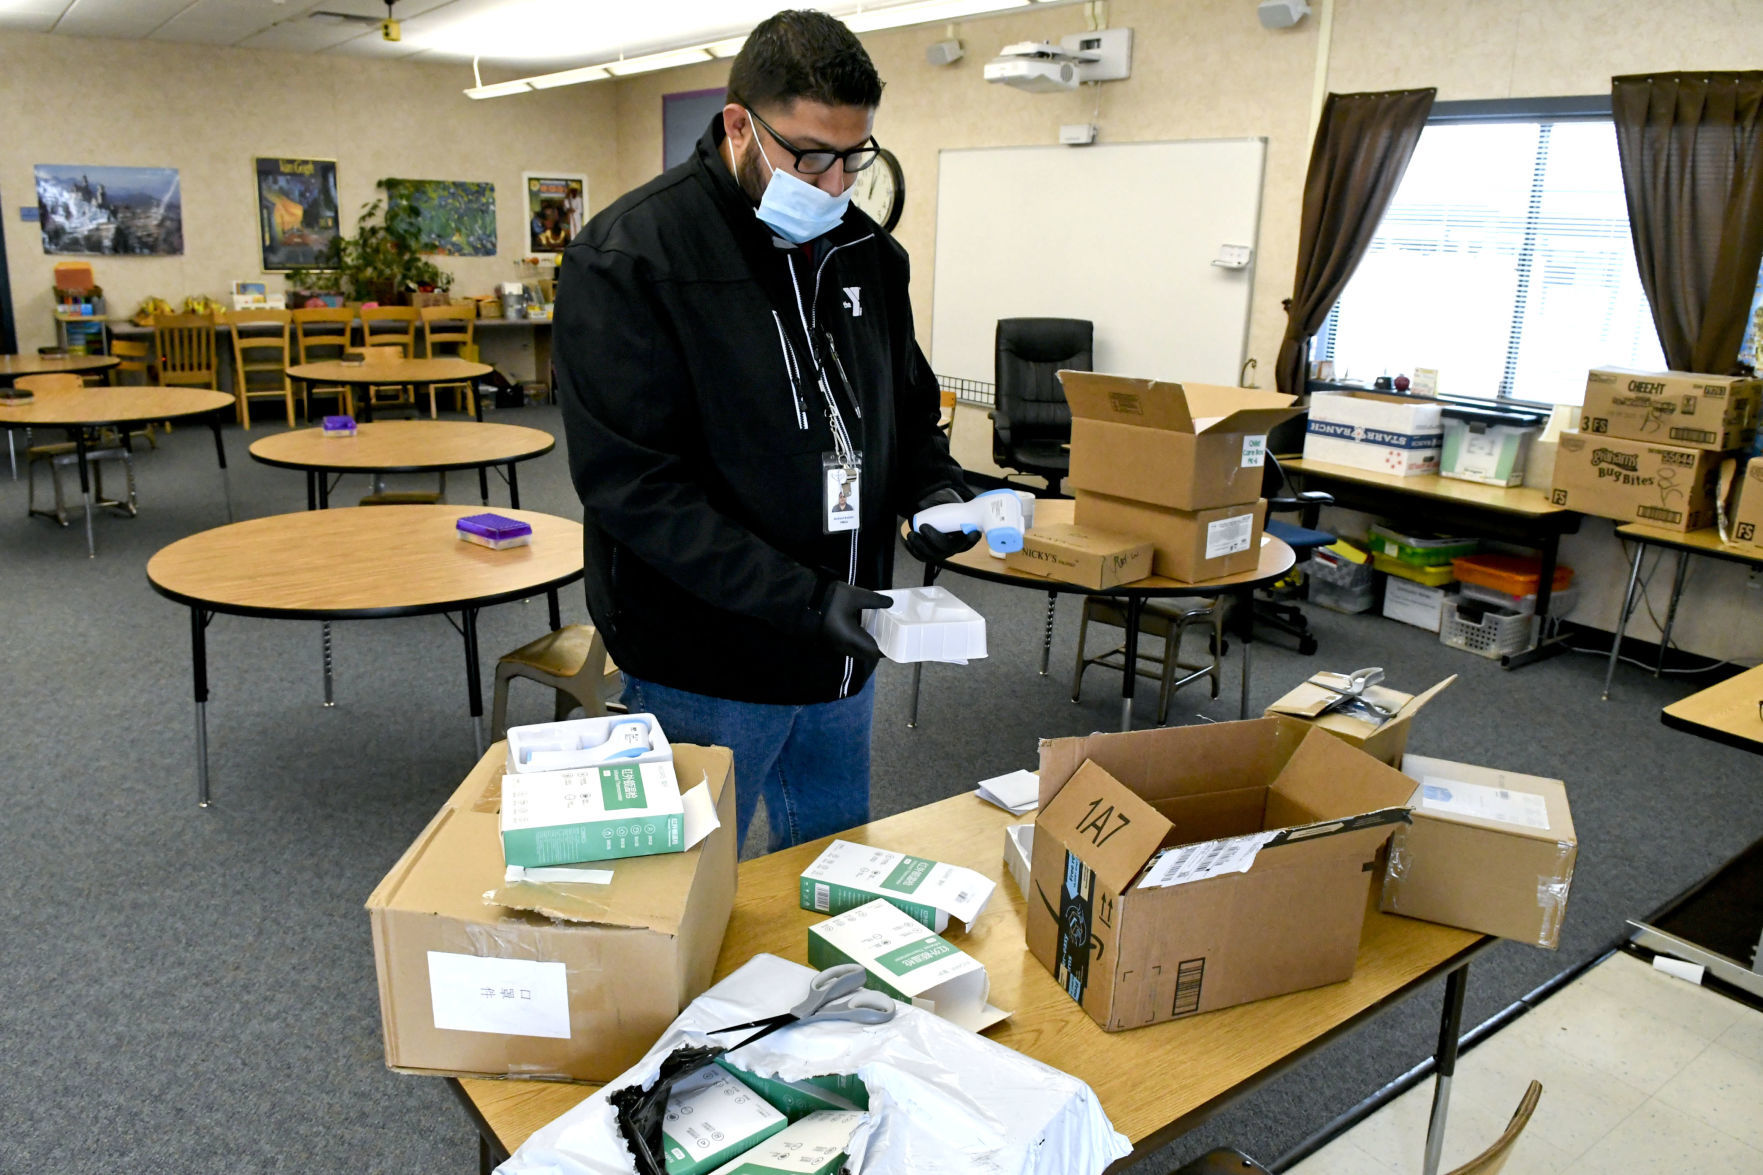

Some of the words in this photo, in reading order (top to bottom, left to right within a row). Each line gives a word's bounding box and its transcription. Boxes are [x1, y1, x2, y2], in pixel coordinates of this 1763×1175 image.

[1310, 421, 1351, 437] RANCH
[1582, 416, 1590, 431] 3
[1593, 418, 1607, 432] FS
[1366, 429, 1407, 446] STARR
[1598, 467, 1622, 482] Bug
[1622, 474, 1654, 486] Bites
[1553, 490, 1567, 505] FS
[1738, 524, 1755, 541] FS
[1022, 547, 1057, 563] NICKY'S
[1076, 797, 1131, 848] 1A7
